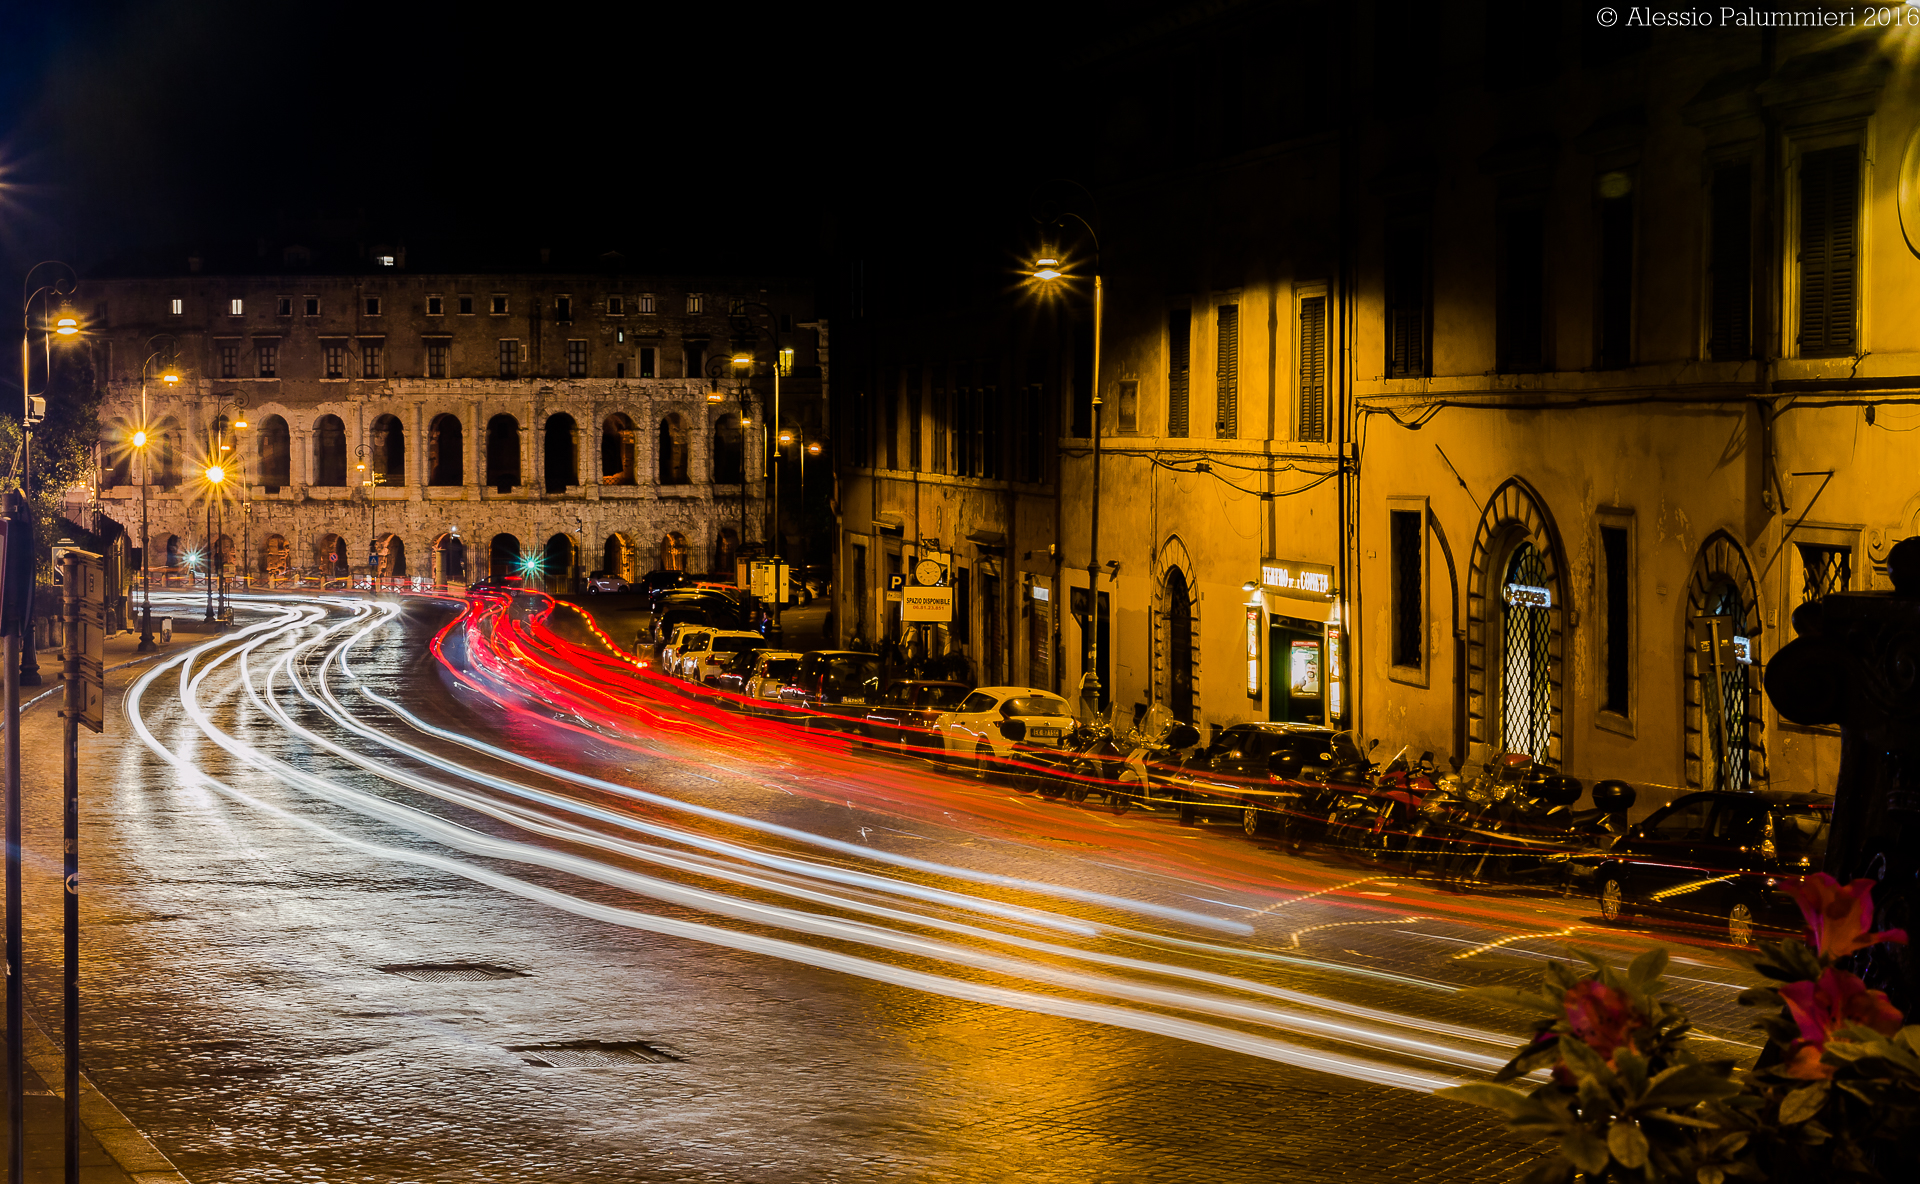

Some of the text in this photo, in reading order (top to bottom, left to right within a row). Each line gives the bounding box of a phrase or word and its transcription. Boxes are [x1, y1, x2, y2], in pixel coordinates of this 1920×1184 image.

[891, 575, 902, 589] P
[1262, 566, 1288, 587] TEATRO
[906, 597, 951, 605] SPAZIO DISPONIBILE
